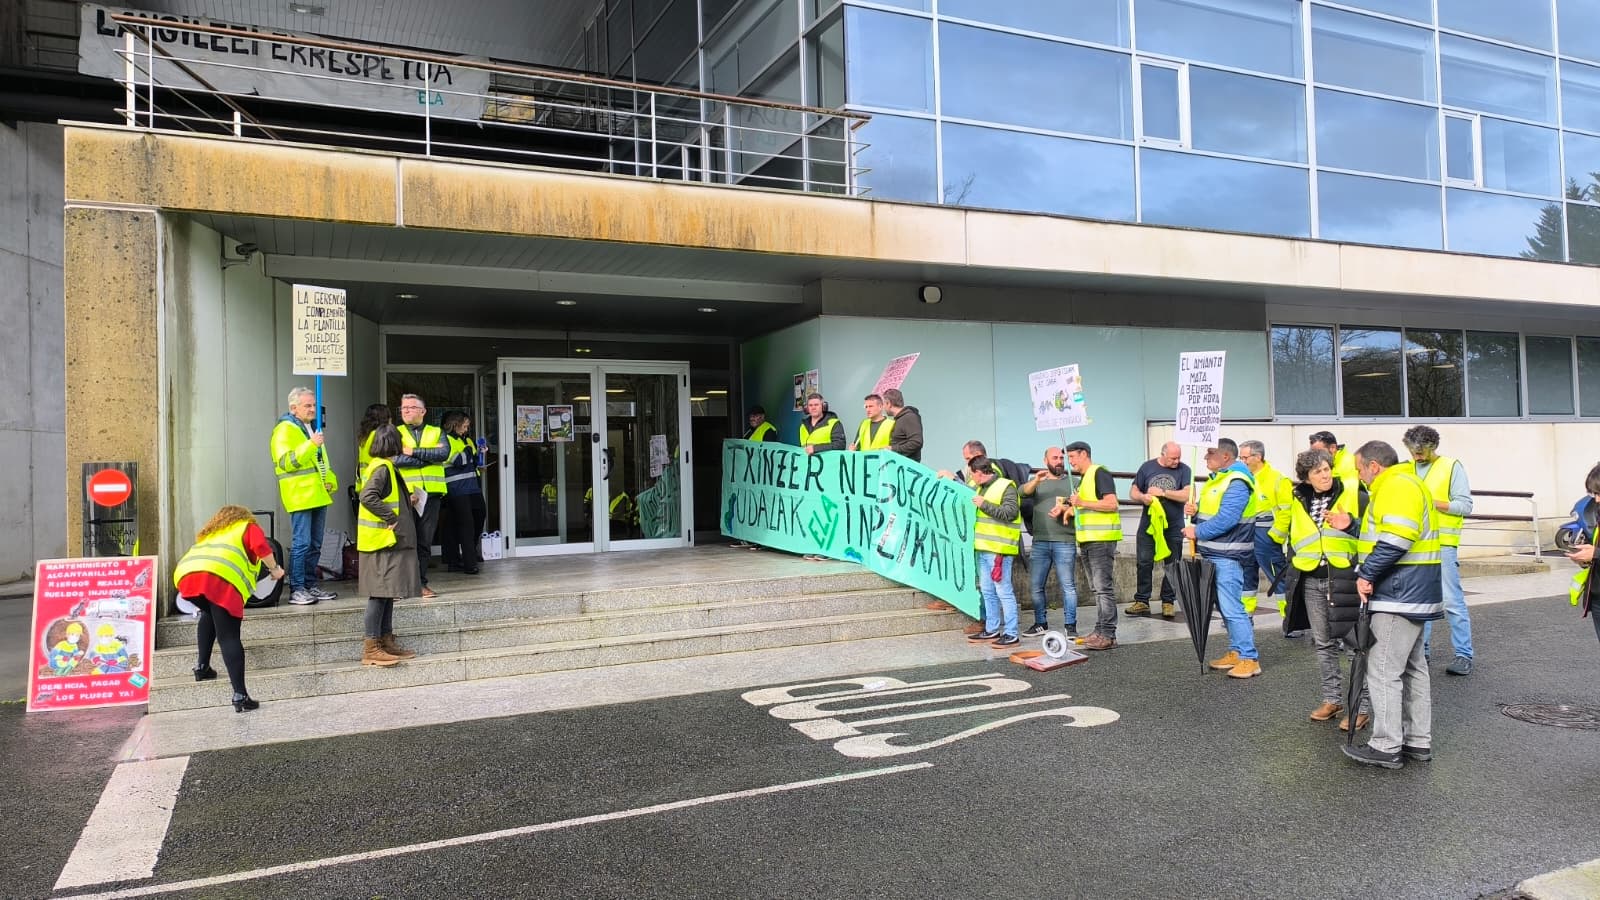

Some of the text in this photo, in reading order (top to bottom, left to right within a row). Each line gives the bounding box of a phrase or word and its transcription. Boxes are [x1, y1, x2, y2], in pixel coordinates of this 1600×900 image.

[418, 90, 444, 106] ELA
[297, 290, 346, 306] LA GERENCIA
[297, 317, 309, 330] LA
[304, 332, 341, 343] SUELDOS
[305, 343, 344, 354] MODESTOS
[1181, 355, 1223, 371] EL AMIANTO
[1189, 371, 1207, 383] MATA
[1188, 393, 1220, 404] POR HORA
[1201, 432, 1212, 442] YA
[727, 443, 824, 492] TXINZER
[840, 453, 968, 543] NEGOZIATU
[736, 488, 806, 539] UDALAK
[807, 494, 839, 551] ELA
[46, 561, 120, 571] MANTENIMIENTO
[46, 569, 127, 579] ALCANTARILLADO
[91, 679, 121, 687] PAGAD
